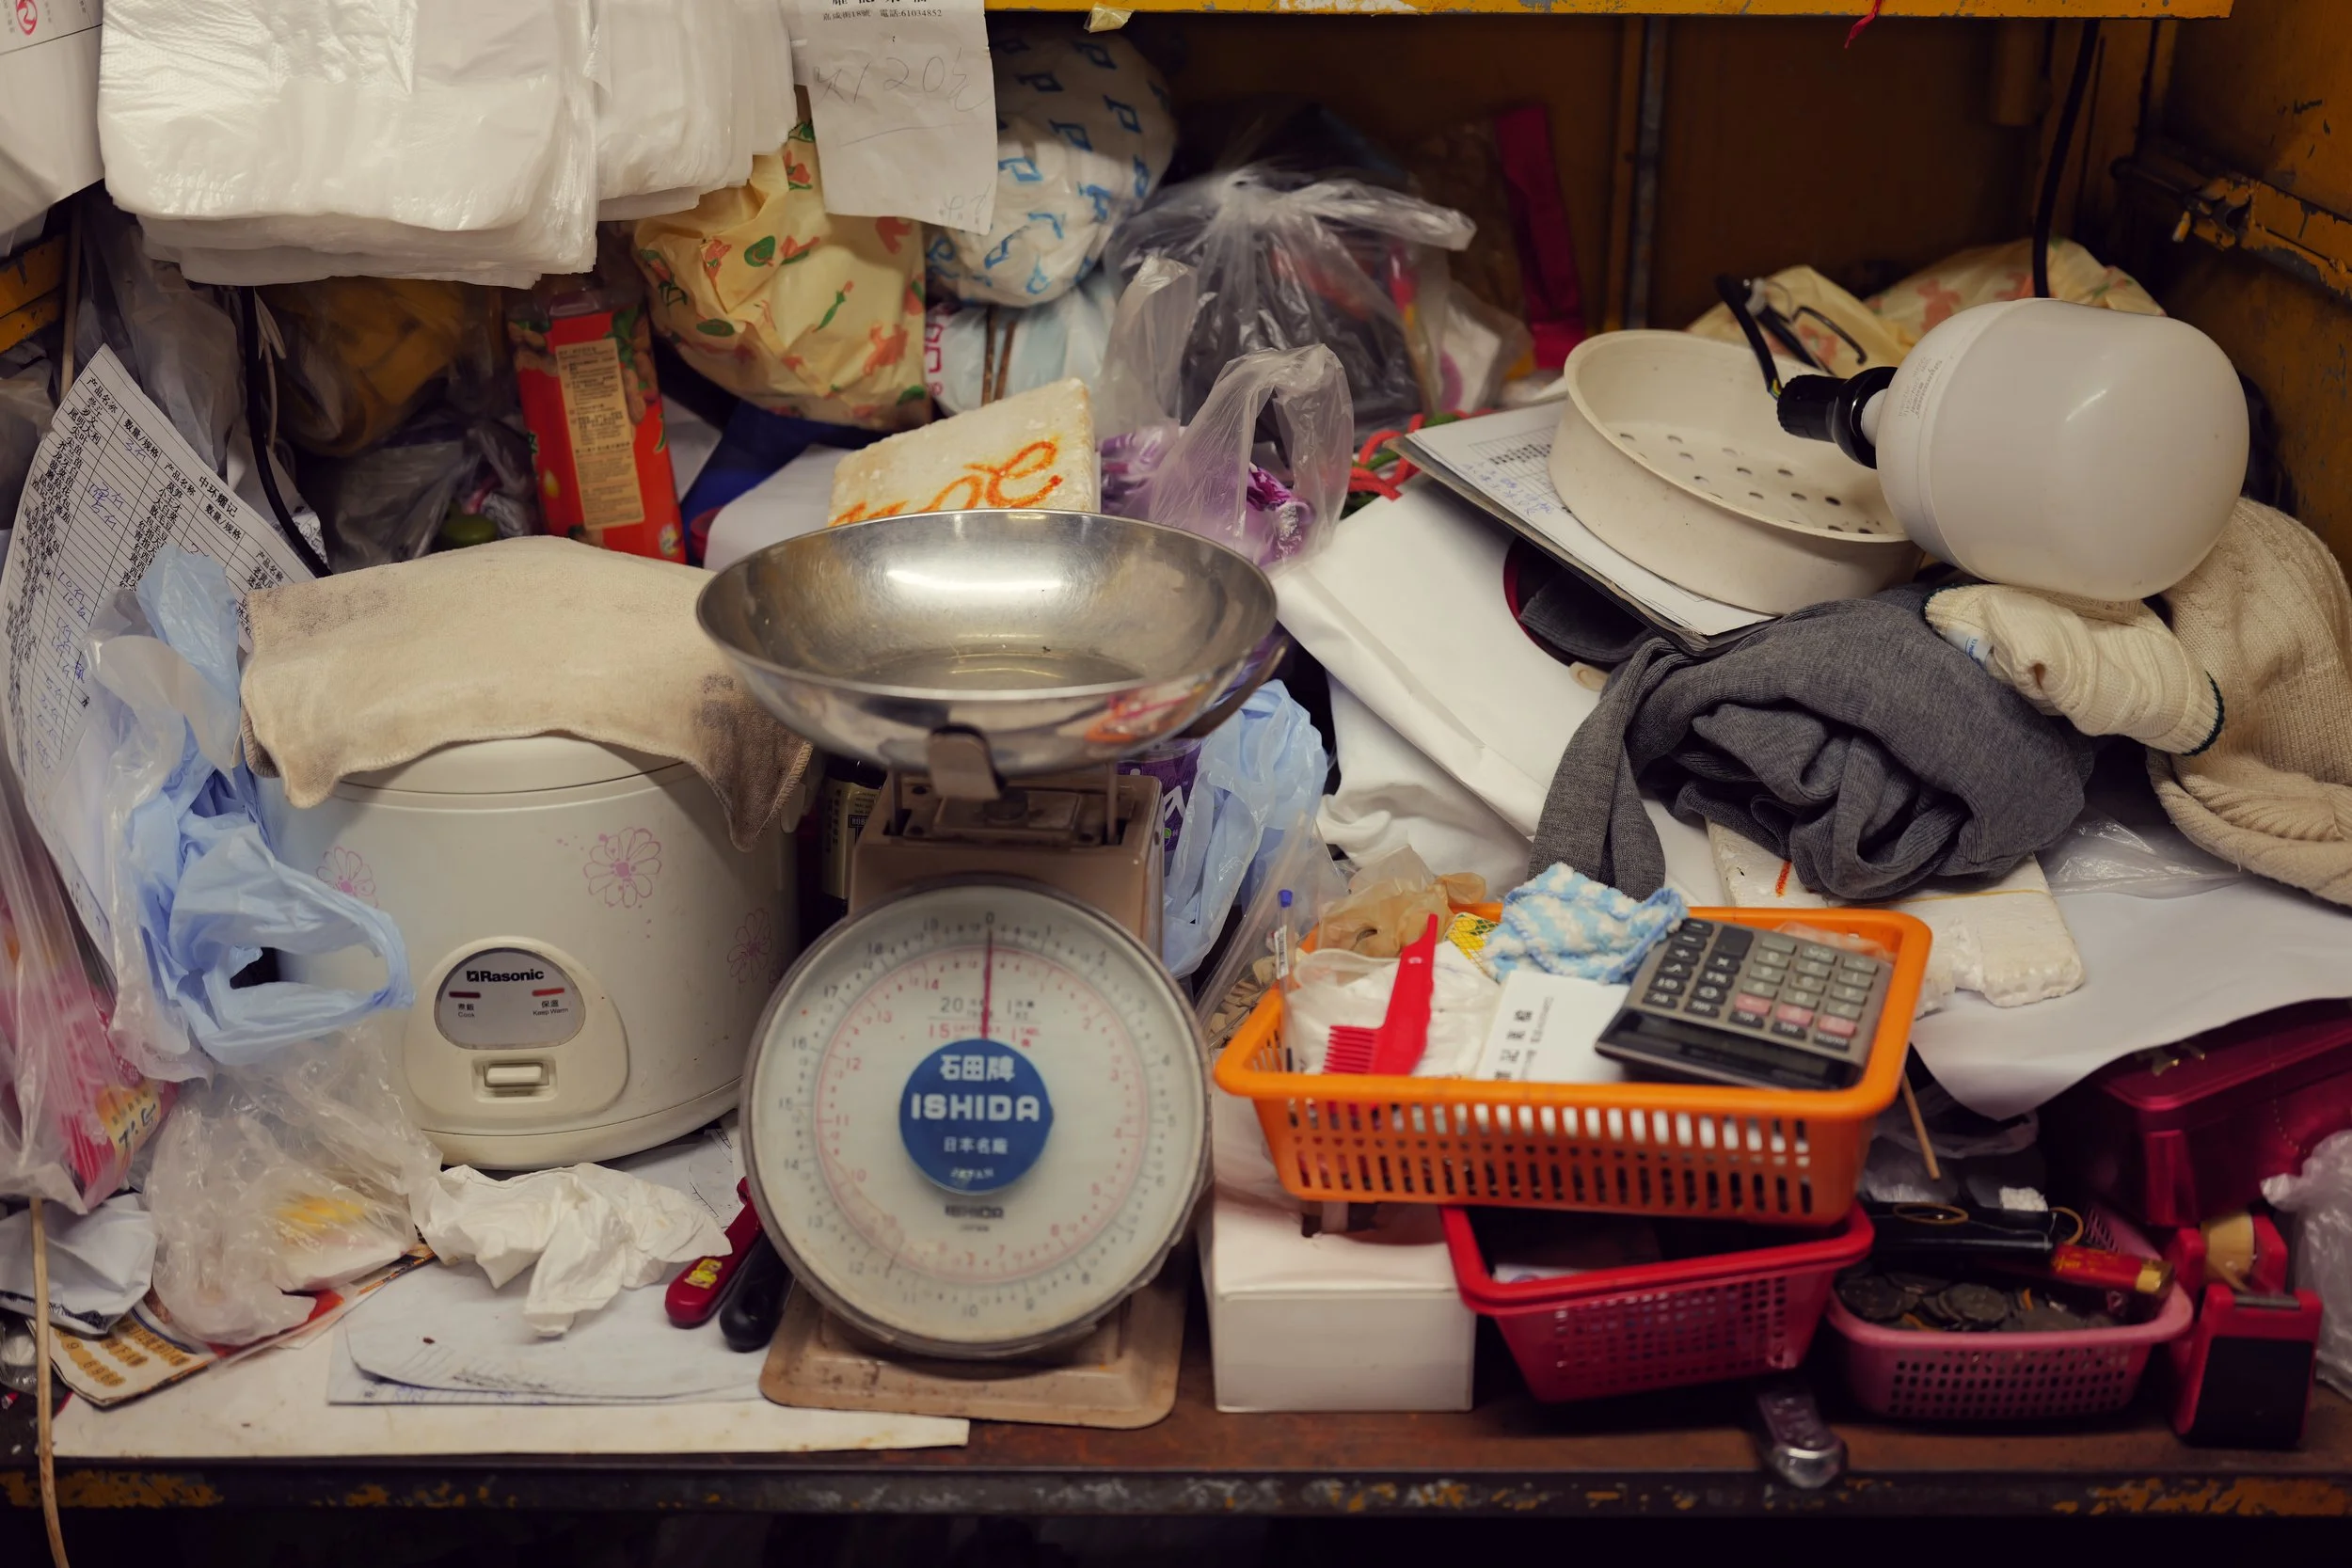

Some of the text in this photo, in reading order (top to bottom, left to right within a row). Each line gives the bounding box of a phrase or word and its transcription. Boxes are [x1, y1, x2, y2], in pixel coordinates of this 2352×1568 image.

[87, 377, 118, 413] 产品名称
[71, 426, 88, 445] 尖叶
[152, 497, 179, 524] 大白菜
[481, 969, 544, 982] Rasonic
[532, 1008, 548, 1017] Keep
[941, 997, 964, 1013] 20
[929, 1022, 950, 1038] 15
[939, 1054, 1015, 1082] 石田牌
[911, 1092, 1041, 1122] ISHIDA
